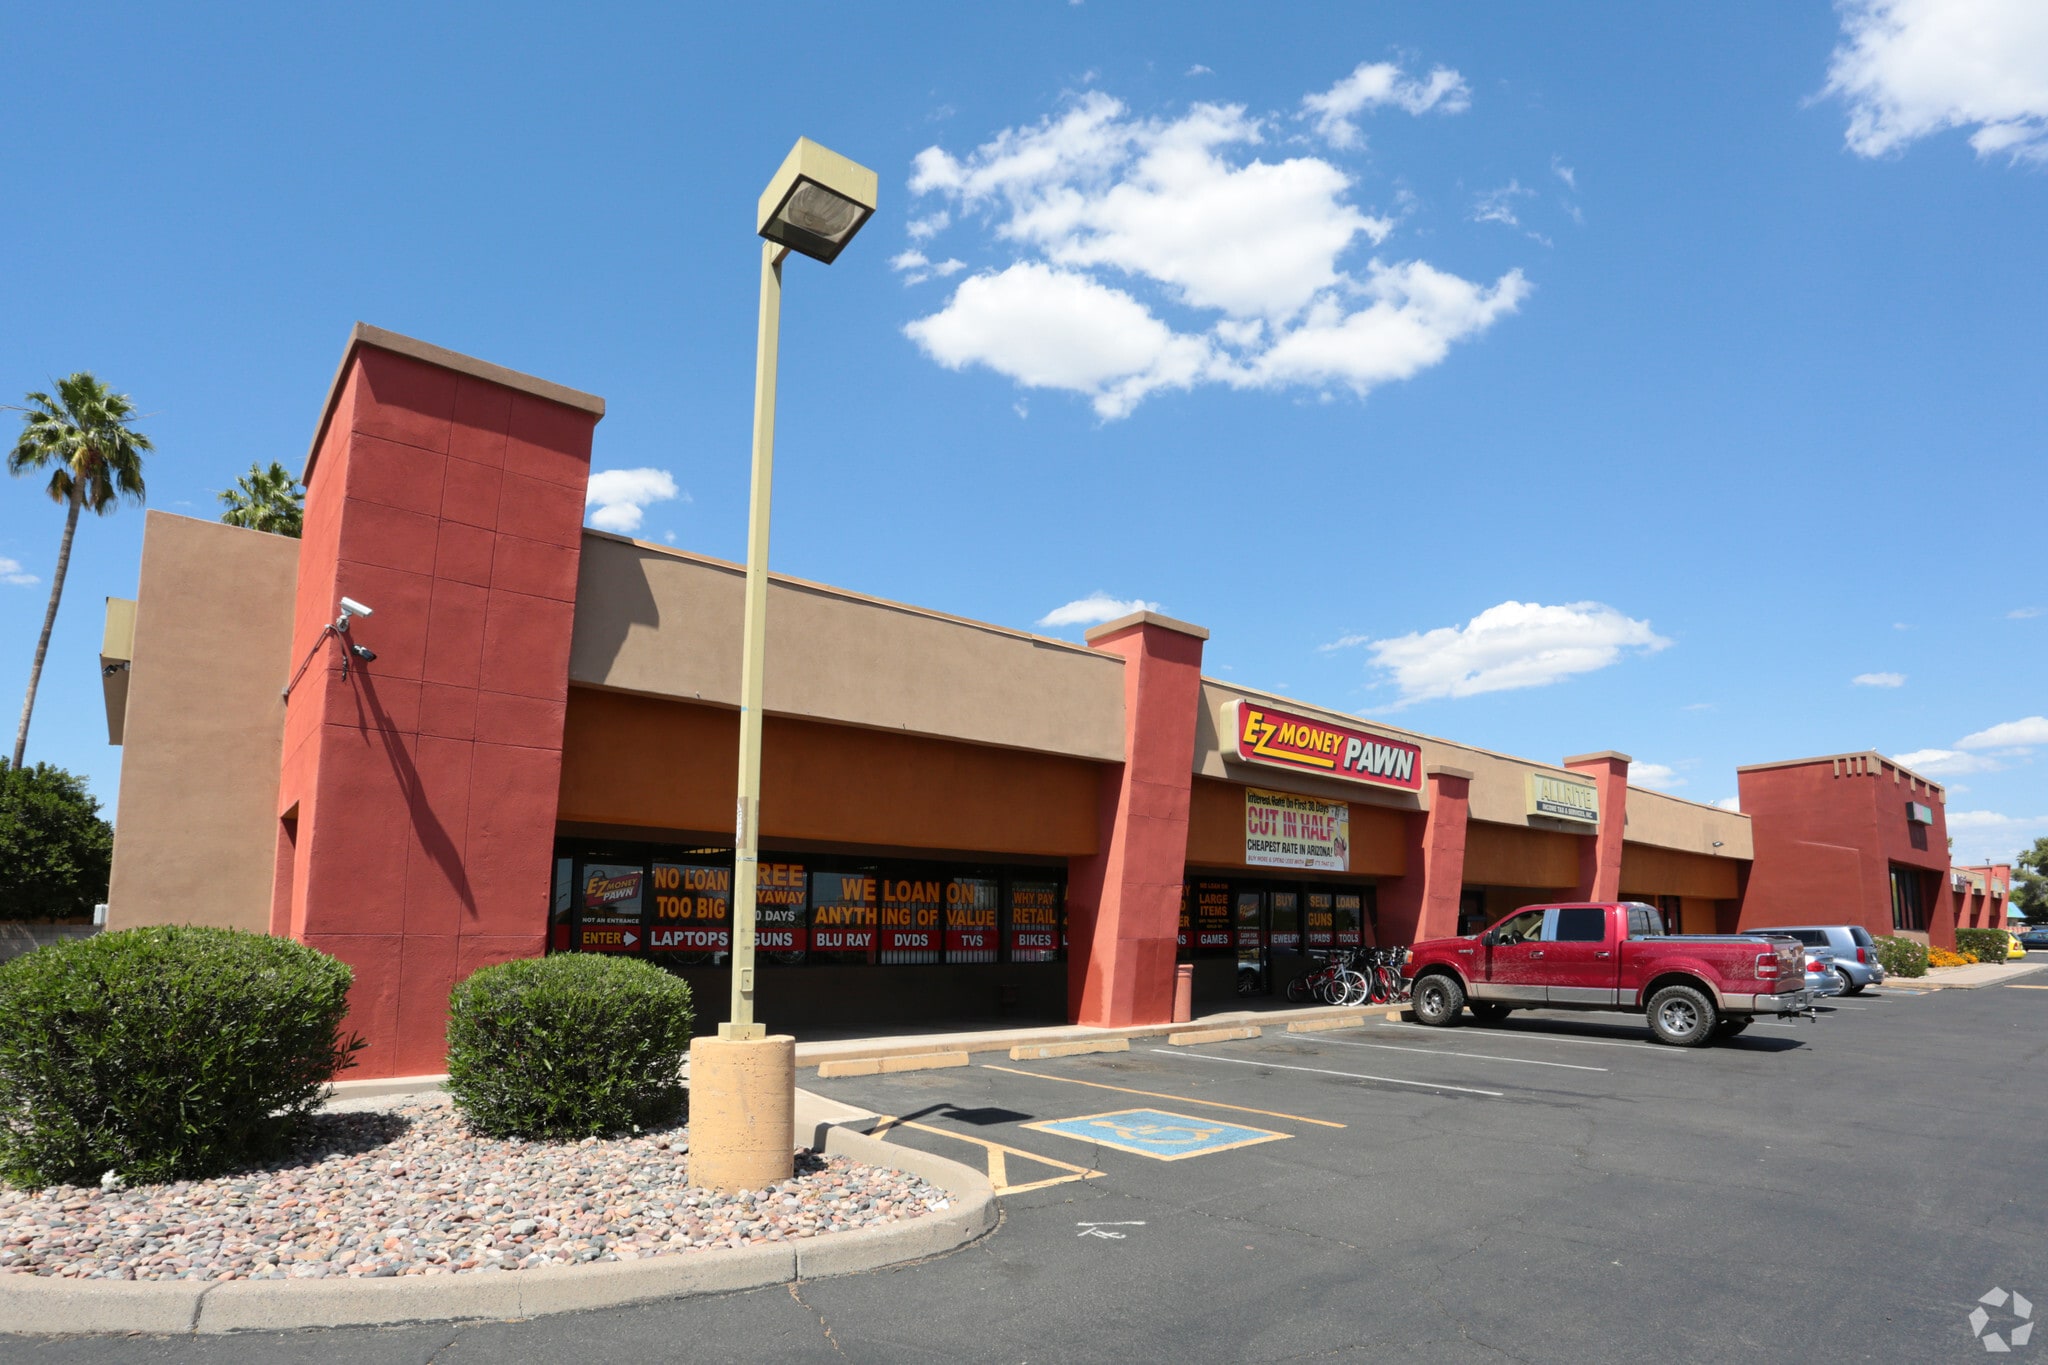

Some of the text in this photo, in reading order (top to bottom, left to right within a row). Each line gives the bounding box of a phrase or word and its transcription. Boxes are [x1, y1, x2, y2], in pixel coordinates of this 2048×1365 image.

[1243, 710, 1414, 780] EZ MONEY PAWN
[1247, 792, 1272, 806] Interest
[1272, 795, 1285, 807] Rate
[1294, 799, 1306, 811] First
[1315, 801, 1329, 815] Days
[1248, 805, 1335, 842] CUT IN HALF
[1247, 839, 1333, 857] CHEAPEST RATE IN ARIZONA!
[654, 866, 729, 891] NO LOAN
[757, 863, 804, 887] REE
[586, 877, 638, 901] EZ MONEY PAWN
[841, 877, 974, 904] WE LOAN ON
[756, 891, 806, 904] YAWAY
[1013, 891, 1055, 905] WHY PAY
[1199, 894, 1228, 904] LARGE
[1275, 894, 1360, 908] BUY SELL LOANS
[656, 896, 726, 919] TOO BIG
[1200, 906, 1227, 916] ITEMS
[765, 911, 795, 921] DAYS
[814, 906, 995, 926] ANYTHING OF VALUE
[1012, 907, 1056, 924] RETAIL
[1308, 912, 1332, 926] GUNS
[582, 931, 621, 945] ENTER
[651, 930, 728, 946] LAPTOPS
[816, 933, 872, 947] BLU RAY
[894, 933, 929, 947] DVDS
[961, 934, 984, 947] TVS
[1018, 934, 1052, 946] BIKES
[1200, 934, 1228, 944] GAMES
[1339, 934, 1359, 942] TOOLS
